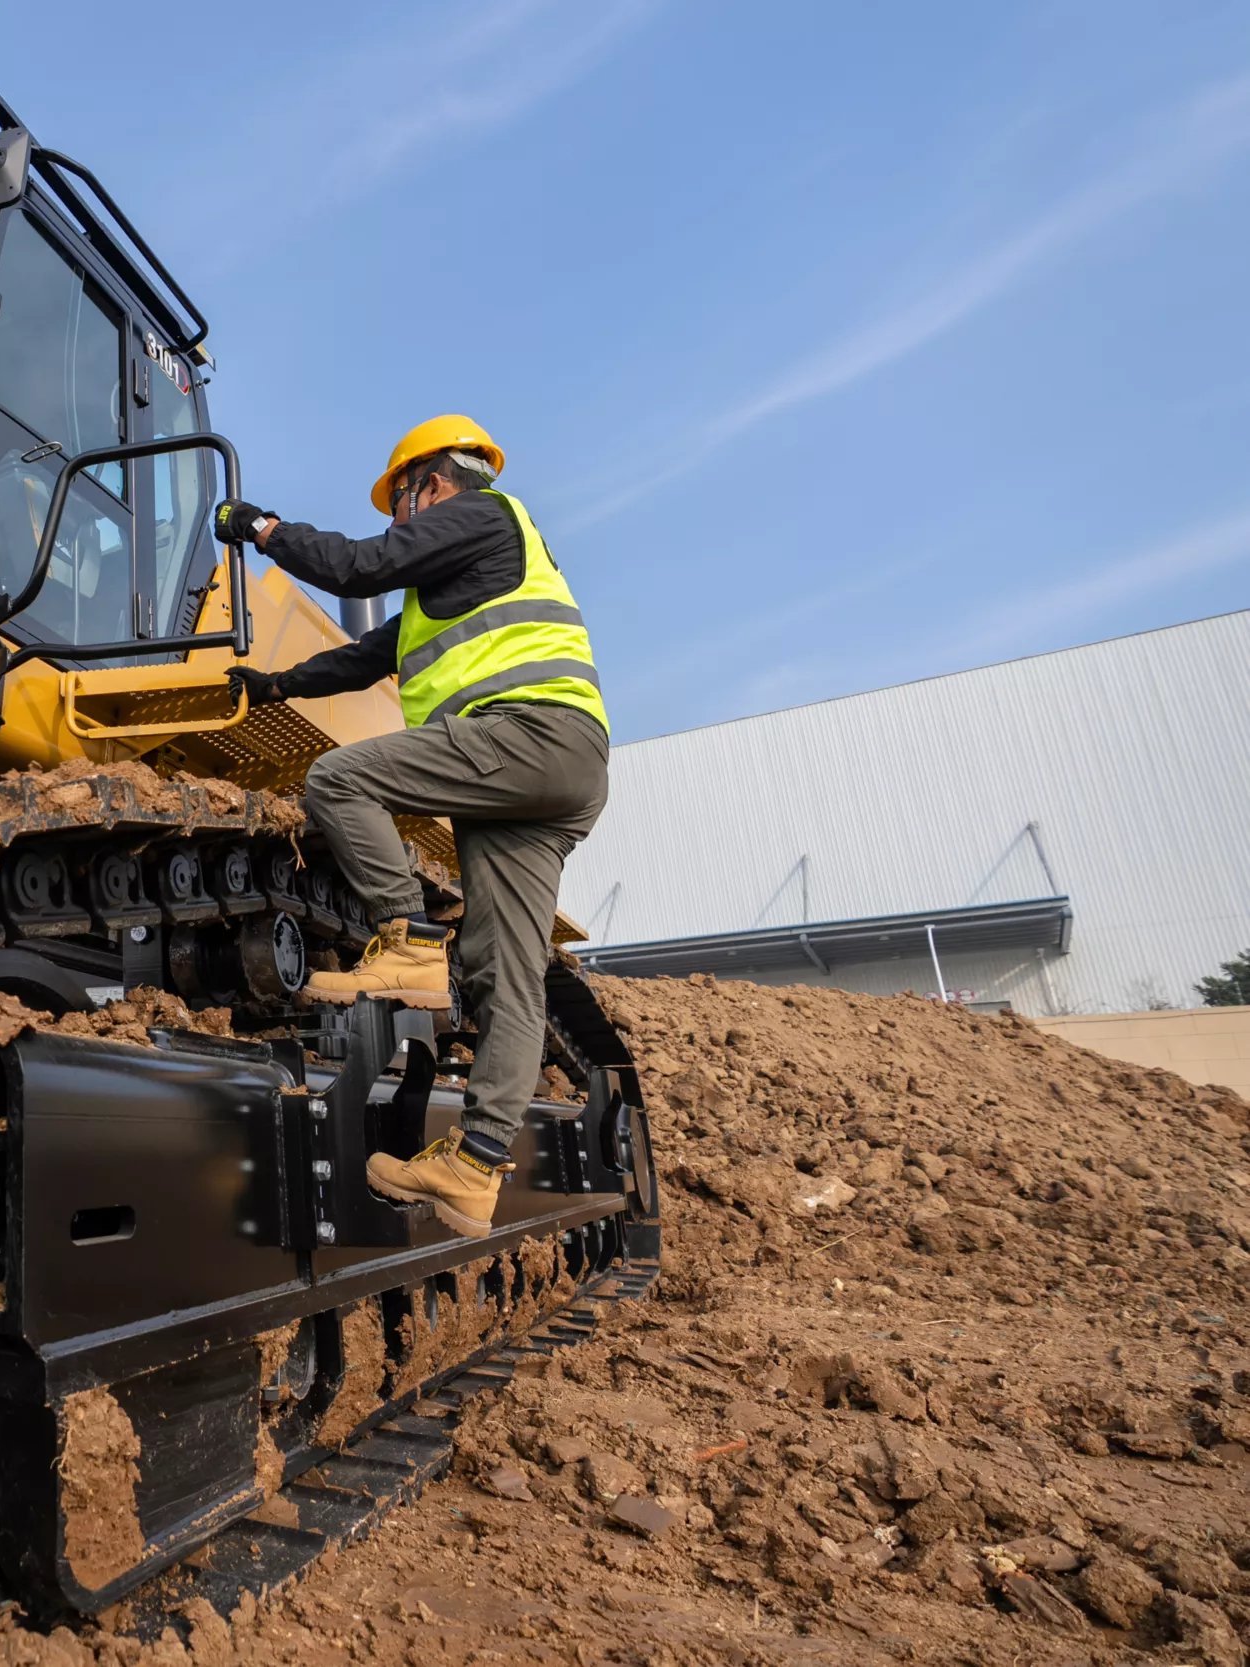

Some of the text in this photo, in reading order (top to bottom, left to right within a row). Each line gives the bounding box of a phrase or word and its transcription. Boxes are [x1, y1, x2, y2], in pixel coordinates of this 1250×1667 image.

[219, 505, 232, 524] CAT
[408, 937, 442, 948] CATERPILLAR
[457, 1151, 491, 1174] CATERPILLAR
